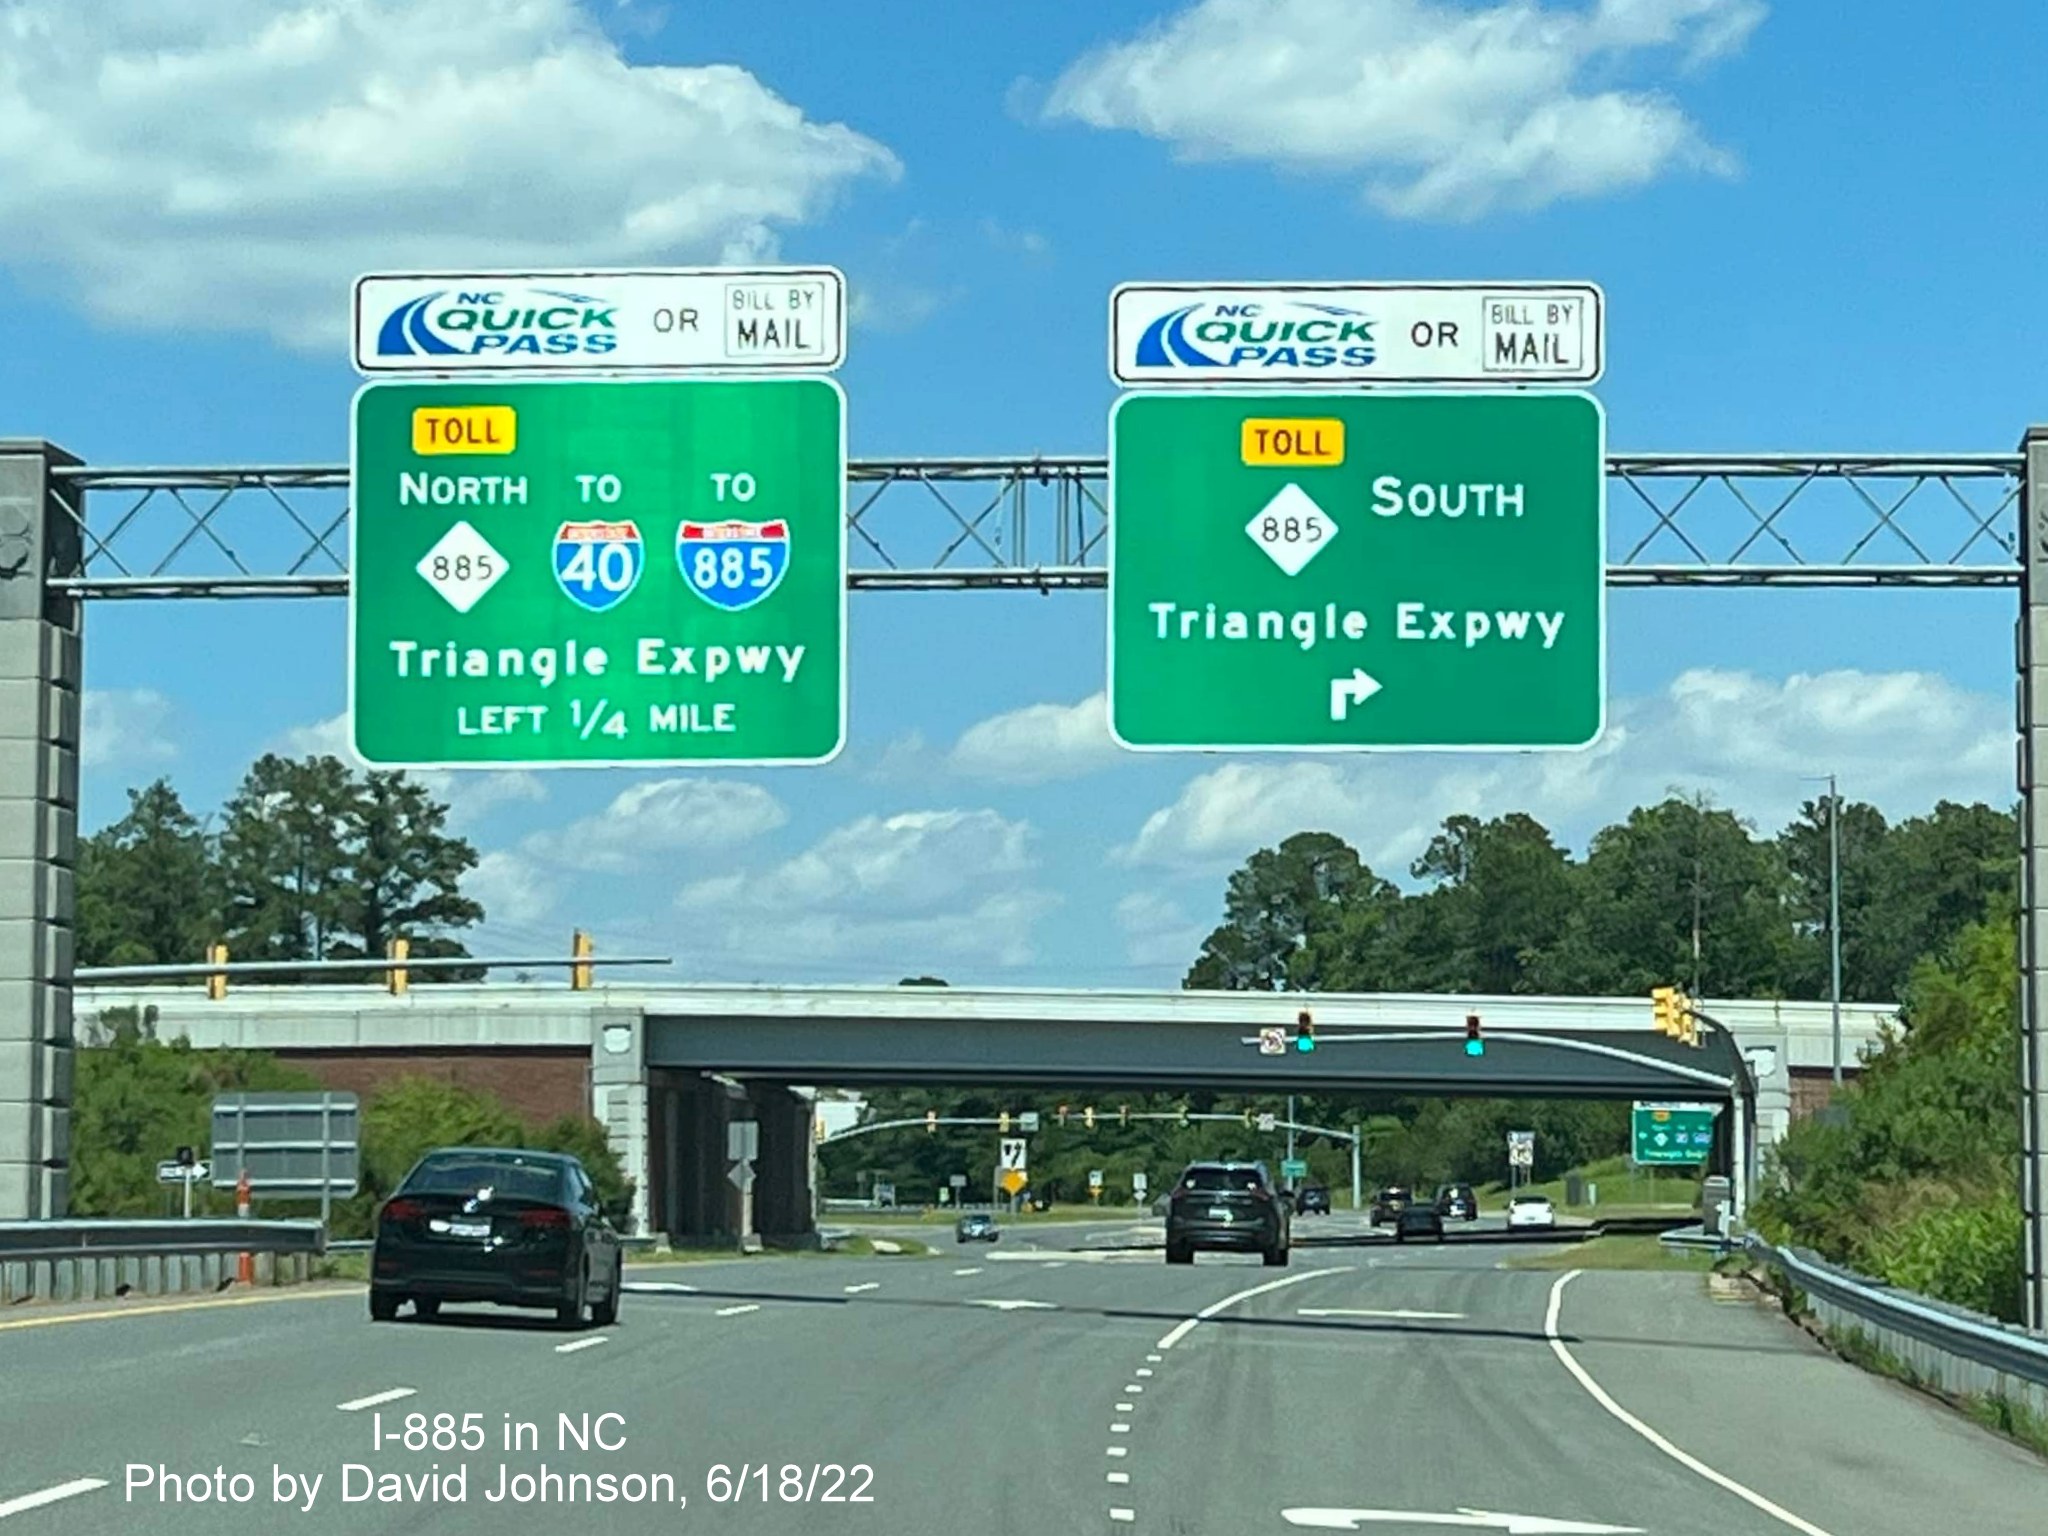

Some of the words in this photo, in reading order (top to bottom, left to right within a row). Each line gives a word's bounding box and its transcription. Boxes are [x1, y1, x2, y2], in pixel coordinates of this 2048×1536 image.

[457, 292, 504, 304] NC
[732, 289, 775, 311] BILL
[789, 288, 815, 310] BY
[1215, 304, 1263, 317] NC
[437, 307, 618, 331] QUICK
[653, 308, 698, 333] OR
[1491, 303, 1533, 326] BILL
[1546, 303, 1574, 326] BY
[471, 334, 617, 354] PASS
[737, 318, 810, 348] MAIL
[1196, 320, 1378, 343] QUICK
[1410, 321, 1459, 348] OR
[1228, 346, 1377, 367] PASS
[1495, 332, 1570, 364] MAIL
[426, 417, 501, 444] TOLL
[1255, 429, 1331, 456] TOLL
[400, 472, 528, 505] NORTH
[576, 474, 622, 502] TO
[711, 472, 756, 501] TO
[1371, 476, 1525, 517] SOUTH
[1261, 516, 1322, 543] 885
[432, 555, 493, 581] 885
[561, 543, 633, 592] 40
[694, 548, 773, 589] 885
[1149, 602, 1368, 650] Triangle
[1396, 602, 1565, 649] Expwy
[389, 639, 609, 687] Triangle
[636, 637, 806, 683] Expwy
[457, 705, 548, 733] LEFT
[570, 699, 627, 739] 1/4
[649, 703, 736, 732] MILE
